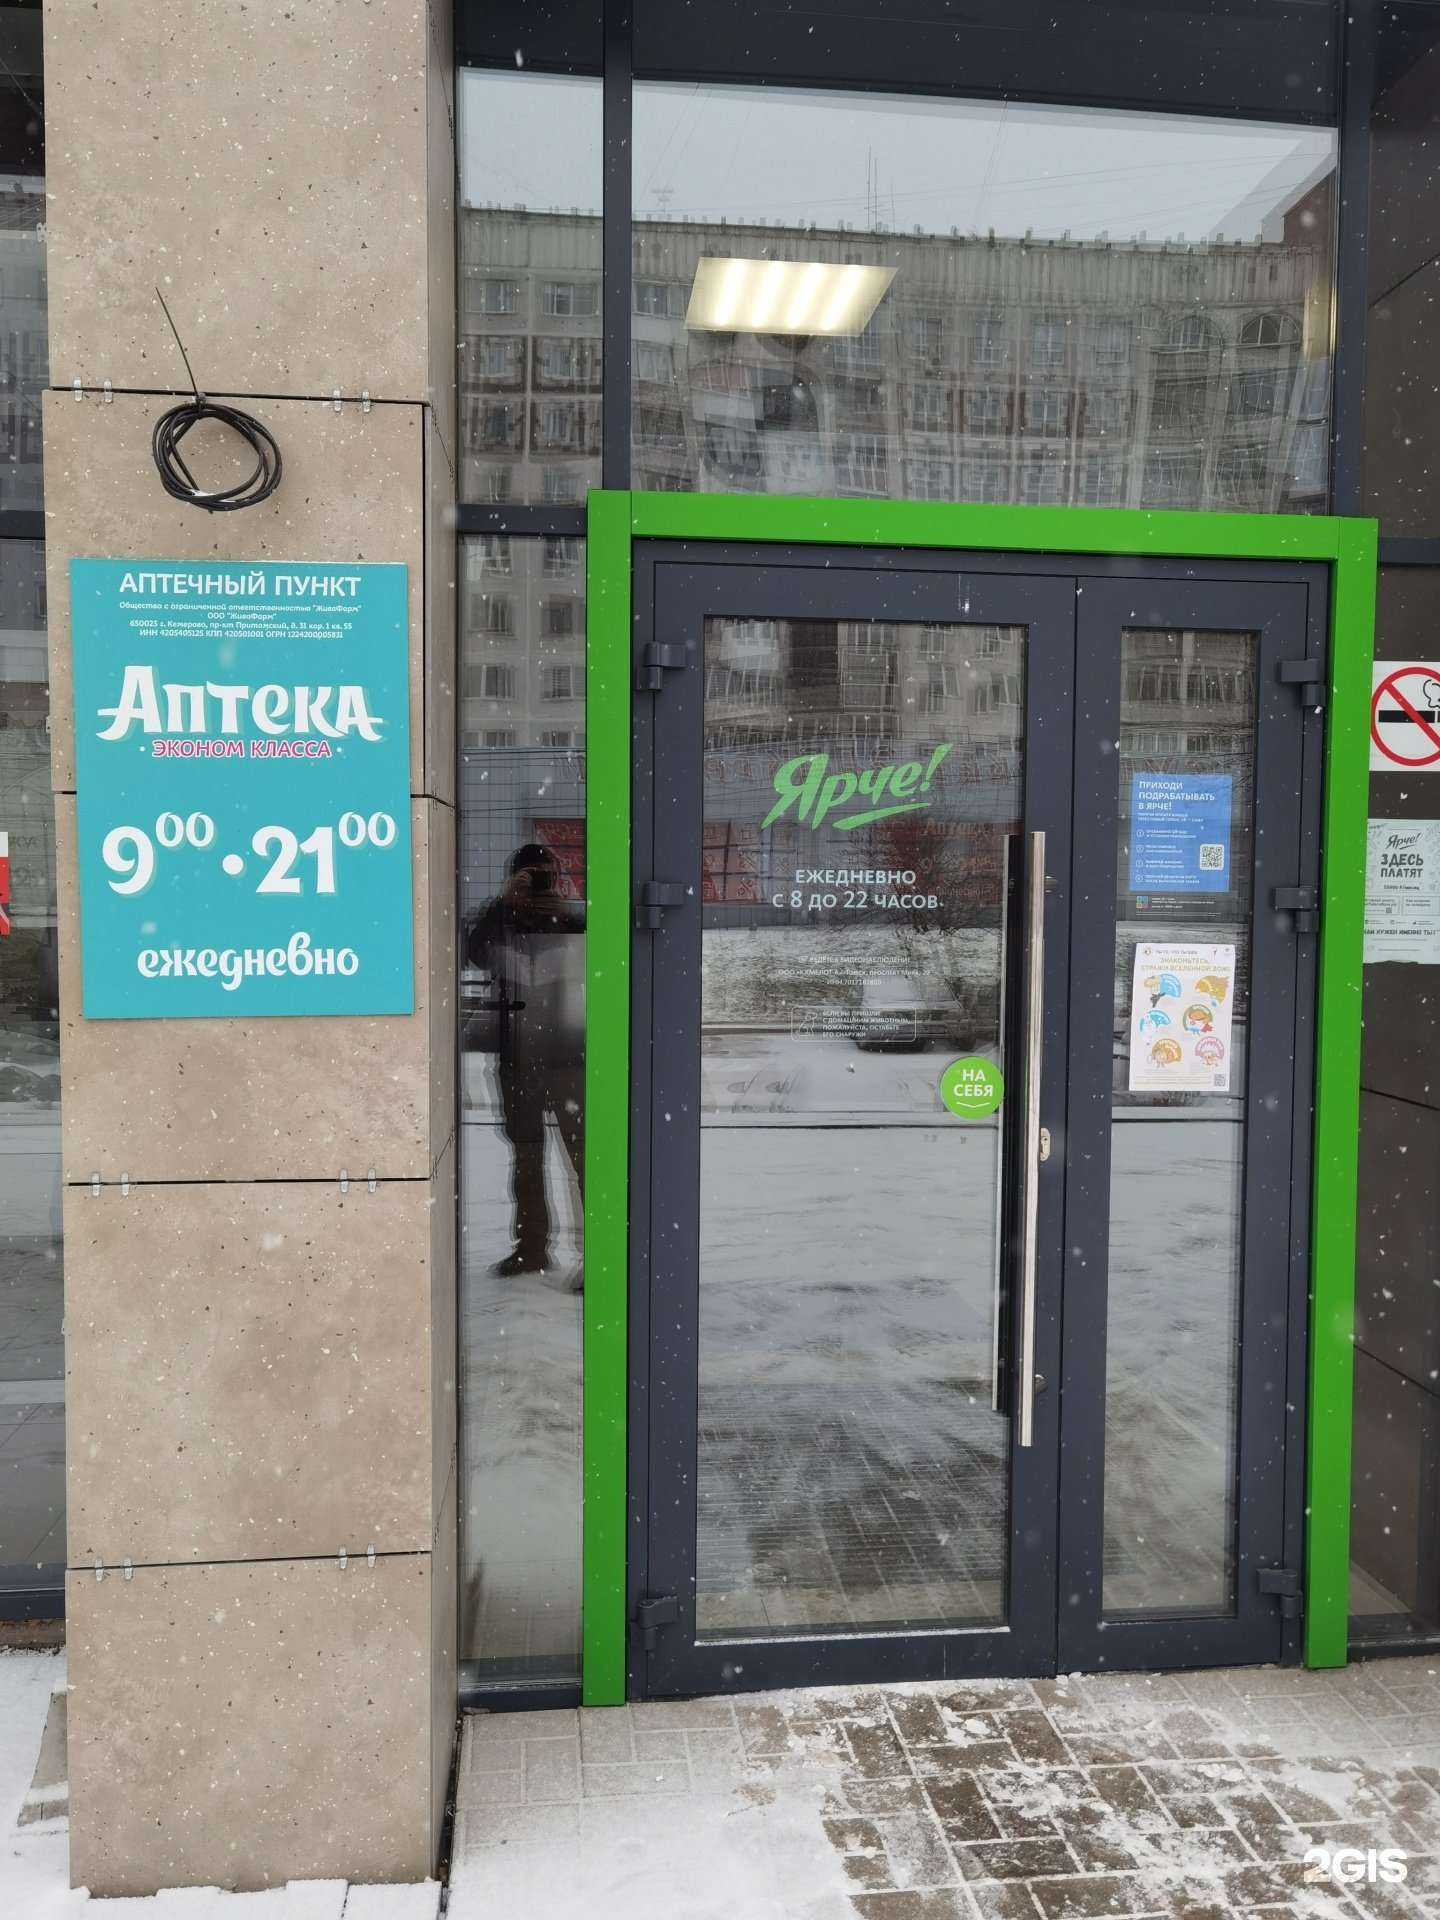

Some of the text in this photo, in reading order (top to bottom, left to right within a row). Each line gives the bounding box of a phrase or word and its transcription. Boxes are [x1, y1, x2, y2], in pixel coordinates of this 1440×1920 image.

[119, 570, 362, 597] АПТЕЧНЫЙ ПУНКТ
[119, 602, 163, 610] Общество
[171, 602, 227, 611] ограниченной
[167, 620, 208, 629] Кемерово,
[235, 622, 289, 631] Притомский,
[139, 629, 159, 637] ИНН
[205, 630, 223, 638] КПП
[265, 630, 286, 638] ОГРН
[151, 739, 332, 759] ЭКОНОМ КЛАССА
[760, 743, 954, 831] Ярче!
[1138, 780, 1183, 790] ПРИХОДИ
[1138, 791, 1215, 801] ПОДРАБАТЫВАТЬ
[1138, 802, 1172, 810] В ЯРЧЕ!
[1386, 833, 1422, 850] Ярче!
[1381, 853, 1424, 867] ЗДЕСЬ
[795, 869, 916, 887] ЕЖЕДНЕВНО
[1380, 868, 1424, 878] ПЛАТЯТ
[790, 890, 802, 908] 8
[808, 894, 837, 911] ДО
[843, 890, 868, 908] 22
[137, 931, 360, 991] ежедневно
[962, 1068, 986, 1081] НА
[953, 1084, 994, 1097] СЕБЯ
